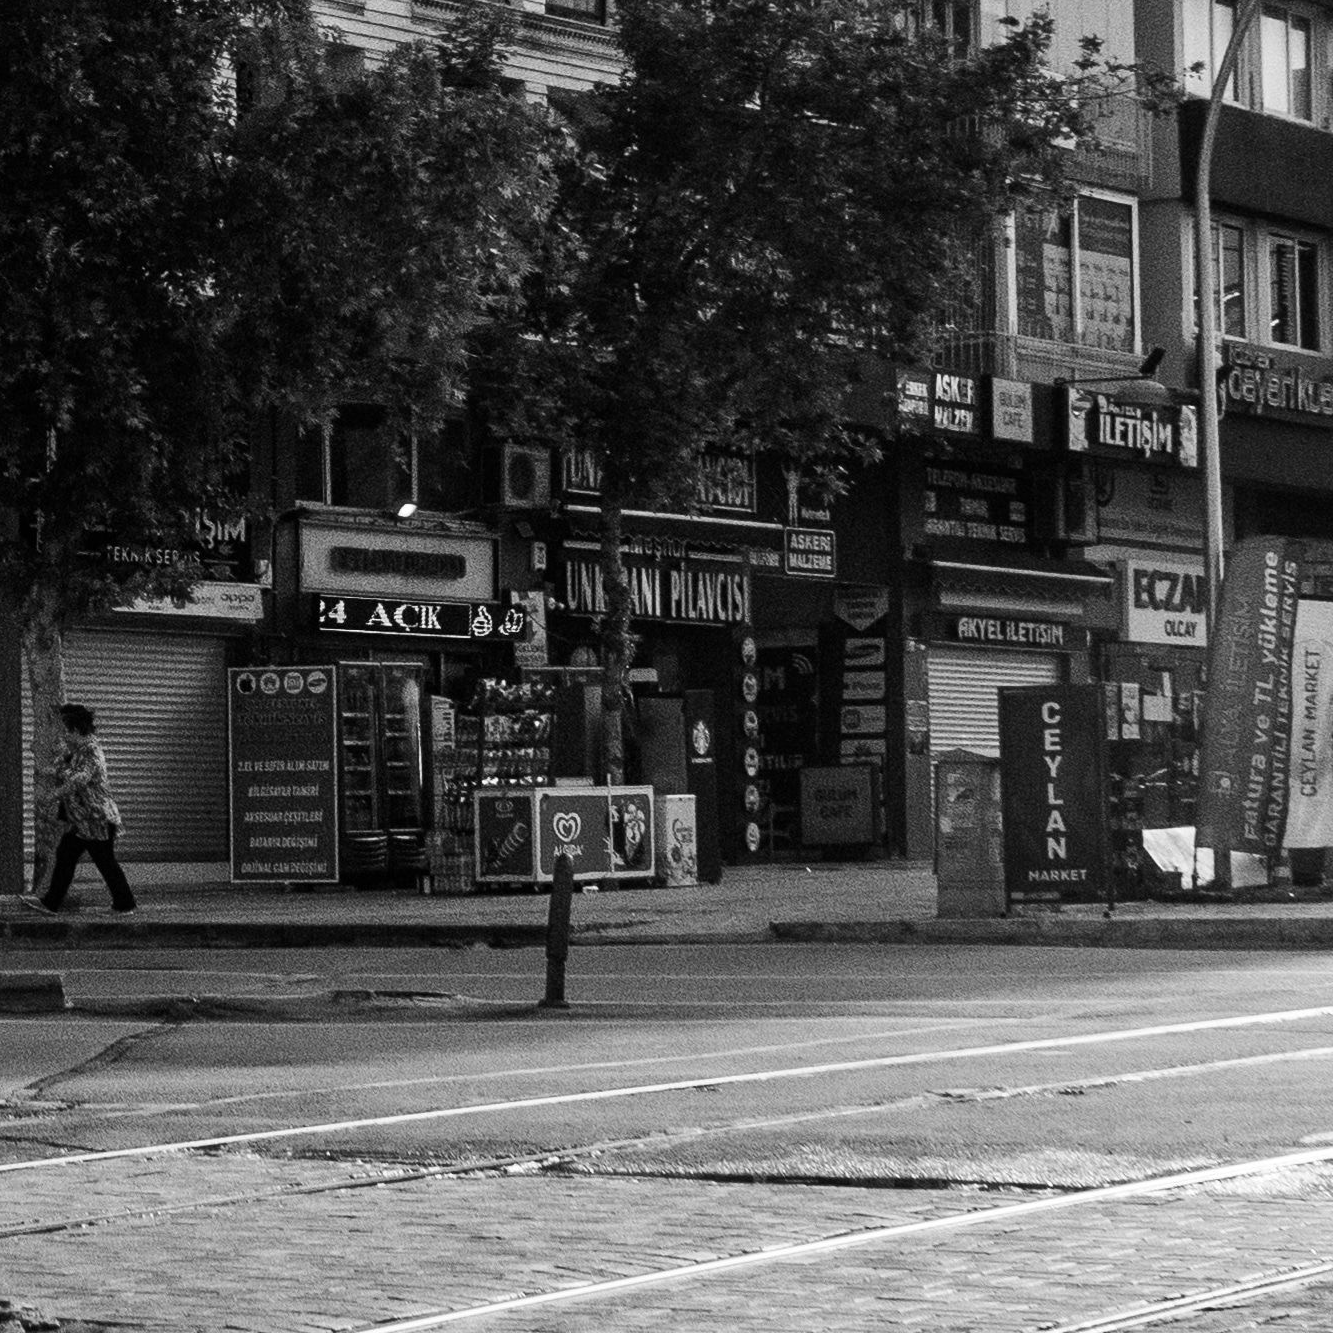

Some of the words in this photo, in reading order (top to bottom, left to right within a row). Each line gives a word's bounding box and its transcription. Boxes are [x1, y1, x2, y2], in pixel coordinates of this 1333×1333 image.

[1099, 410, 1173, 459] İLETİŞİM
[220, 593, 255, 608] oppo
[670, 560, 751, 626] PİLAVCISI
[1256, 550, 1280, 665] yükleme
[364, 603, 443, 633] AÇIK
[957, 616, 1005, 641] AKYEL
[1005, 619, 1065, 648] İLETİŞİM
[1163, 619, 1199, 638] OLCAY
[1253, 672, 1275, 705] TL
[1302, 648, 1322, 721] MARKET
[1253, 714, 1271, 744] ve
[1040, 700, 1068, 861] CEYLAN
[1299, 728, 1320, 799] CEYLAN
[1244, 752, 1269, 841] Fatura
[1028, 869, 1088, 883] MARKET
